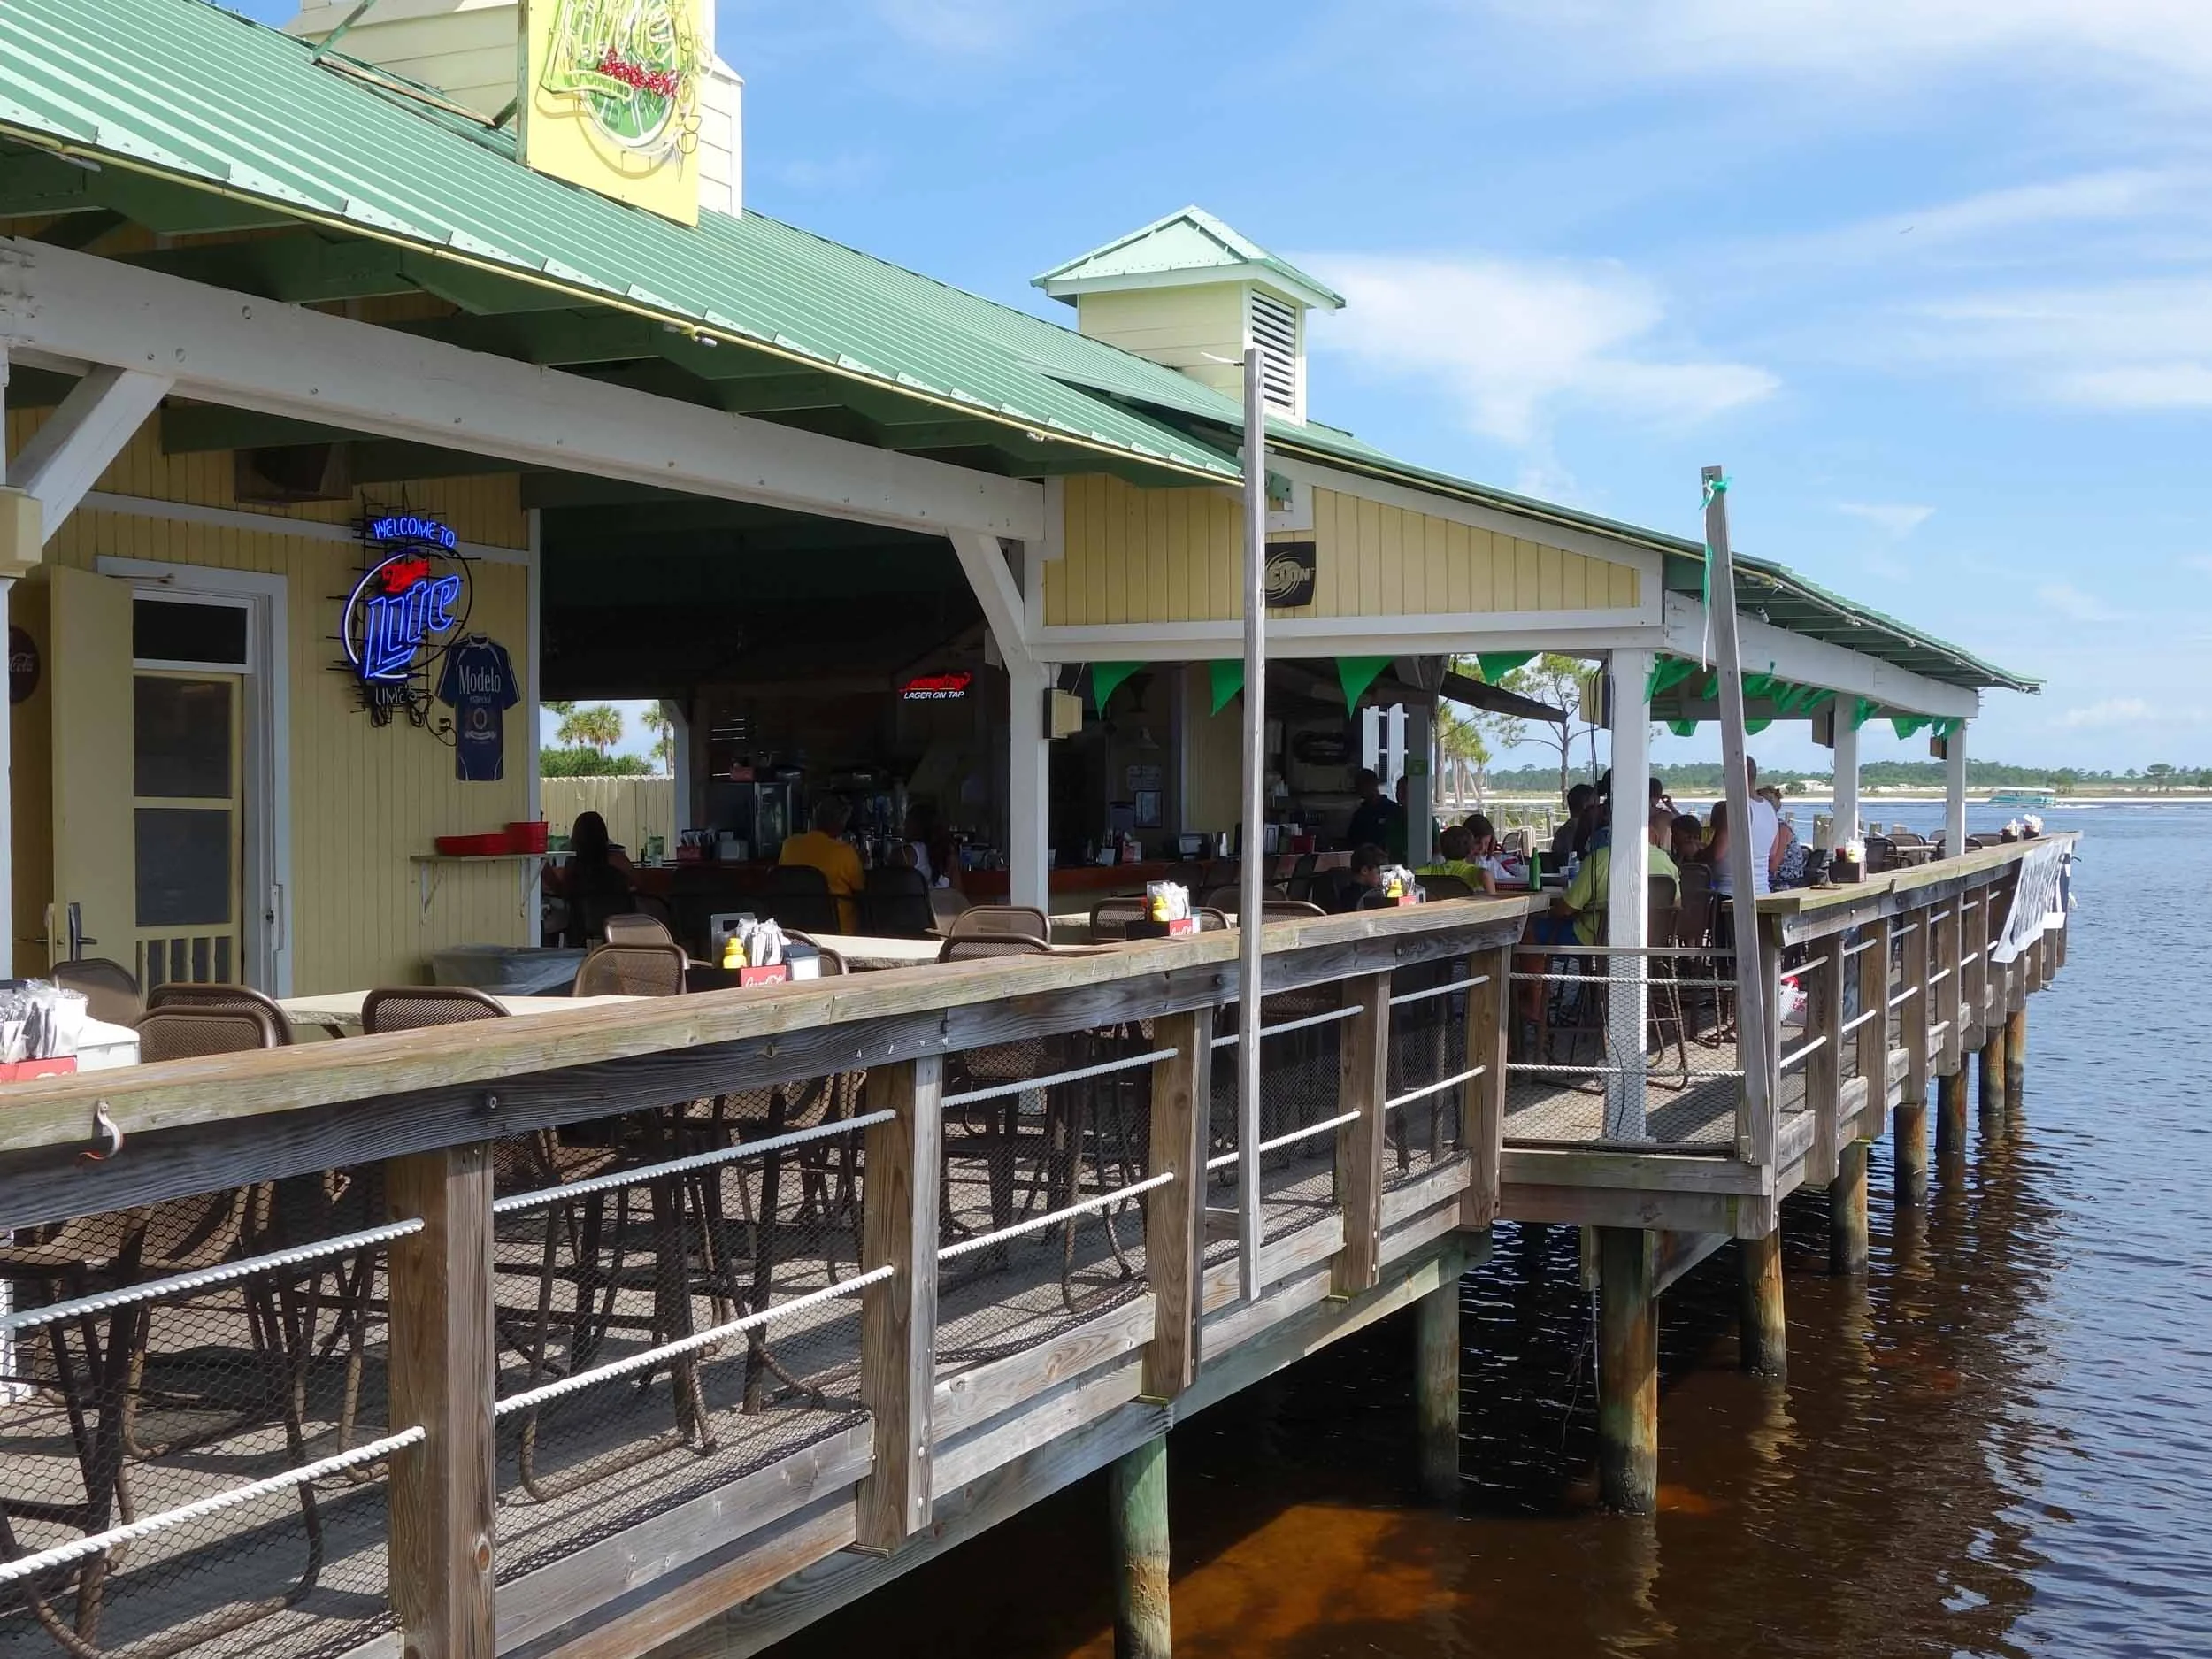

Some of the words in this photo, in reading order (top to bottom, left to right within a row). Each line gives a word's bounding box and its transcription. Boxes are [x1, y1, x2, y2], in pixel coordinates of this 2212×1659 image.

[373, 517, 437, 540] WELCOME
[439, 525, 456, 548] TO
[458, 664, 502, 695] Modelo
[903, 691, 932, 700] LAGER
[933, 691, 947, 700] ON
[949, 690, 965, 699] TAP
